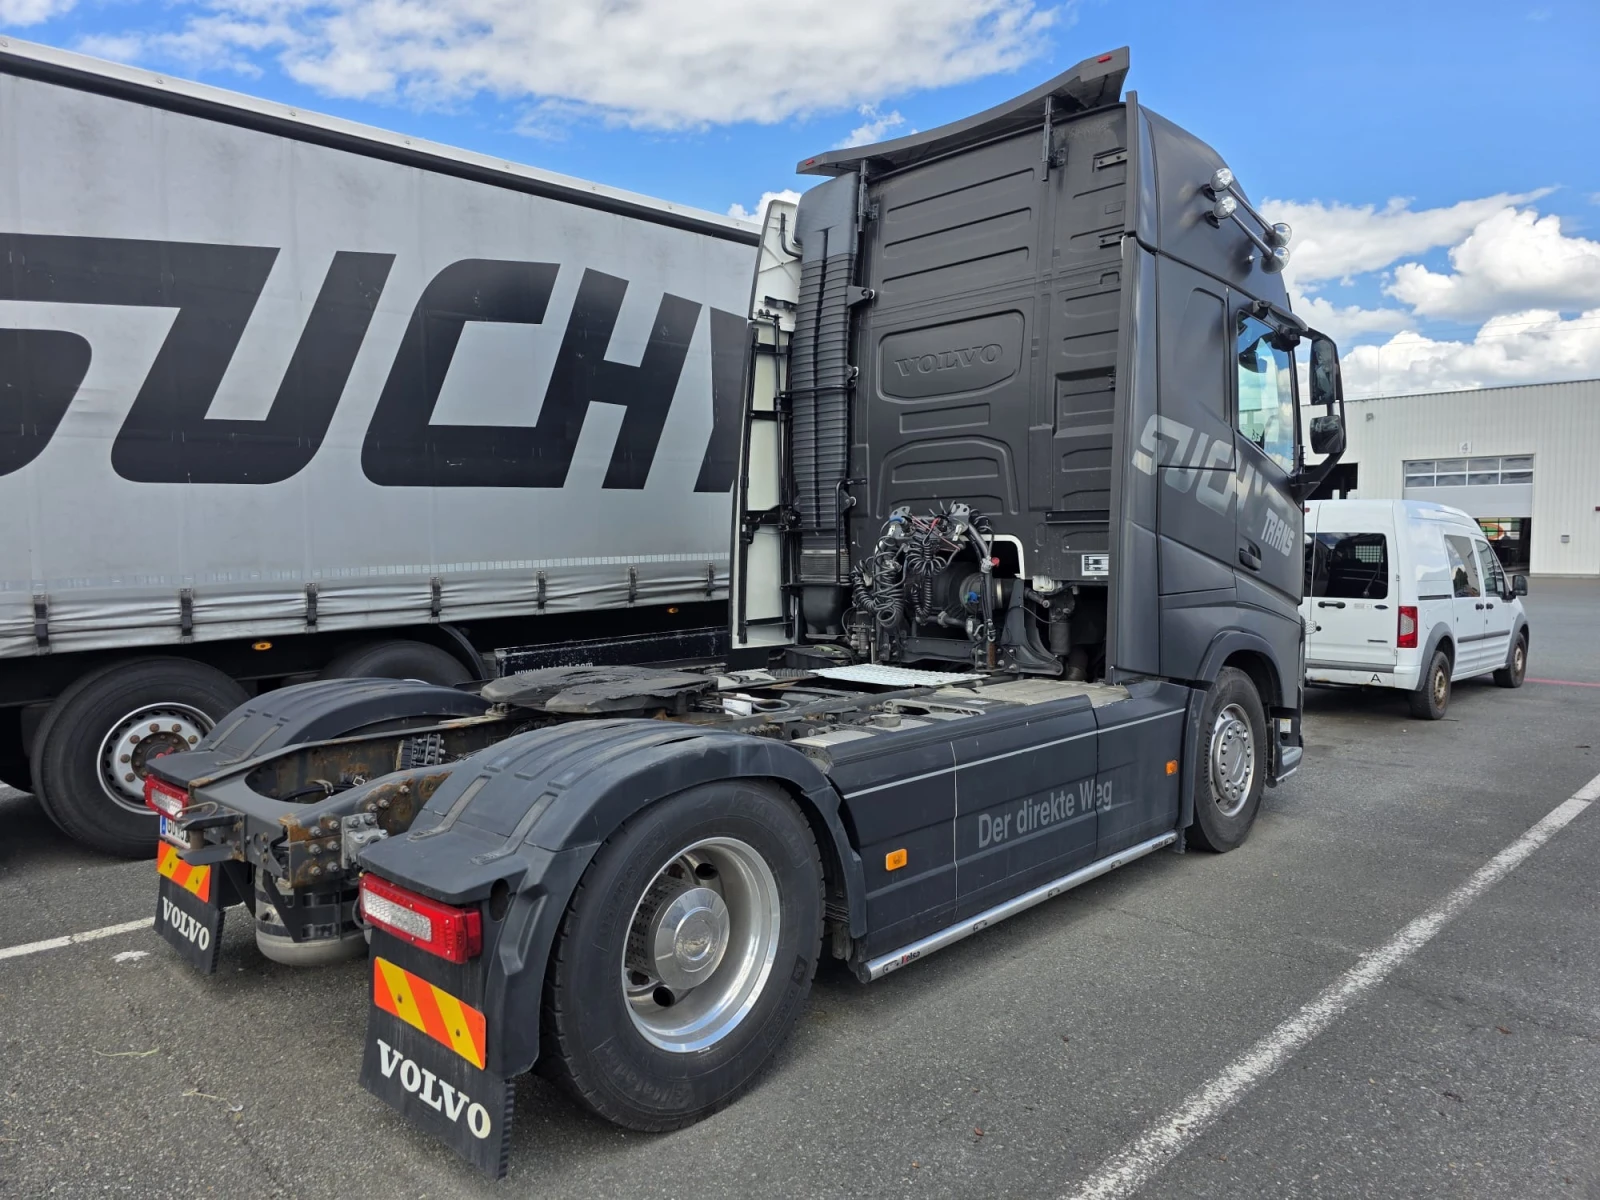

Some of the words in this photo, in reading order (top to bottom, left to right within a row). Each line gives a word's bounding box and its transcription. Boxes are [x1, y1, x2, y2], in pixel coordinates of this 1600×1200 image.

[894, 343, 1003, 377] VOLVO
[1261, 508, 1295, 557] TRANS
[1370, 673, 1382, 684] A
[978, 813, 1011, 848] Der
[1016, 790, 1075, 834] direkte
[1079, 779, 1112, 811] Weg
[162, 896, 210, 951] VOLVO
[376, 1038, 491, 1139] VOLVO
